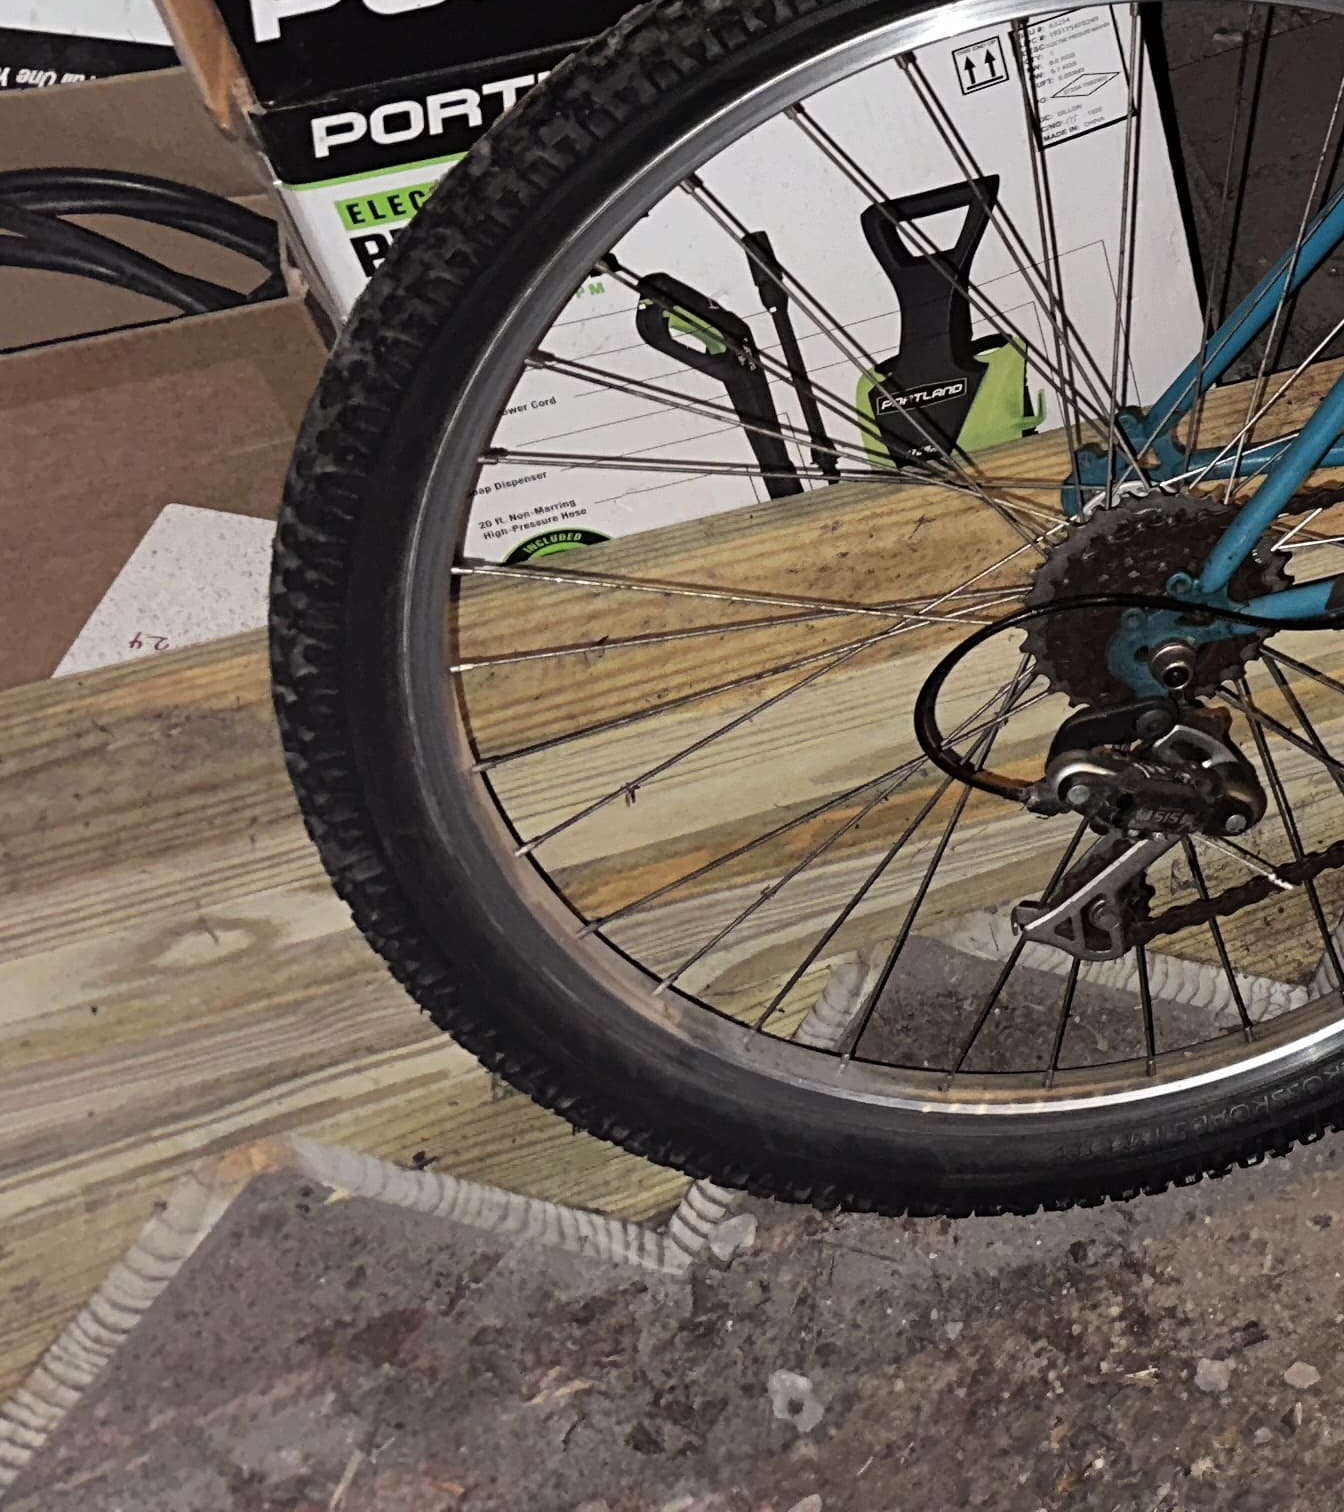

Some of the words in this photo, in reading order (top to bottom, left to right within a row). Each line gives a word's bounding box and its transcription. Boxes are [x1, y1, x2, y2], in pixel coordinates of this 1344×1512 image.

[311, 71, 551, 159] PORT
[346, 189, 428, 225] ELEC
[502, 403, 528, 417] ower
[523, 532, 583, 554] INCLUDED
